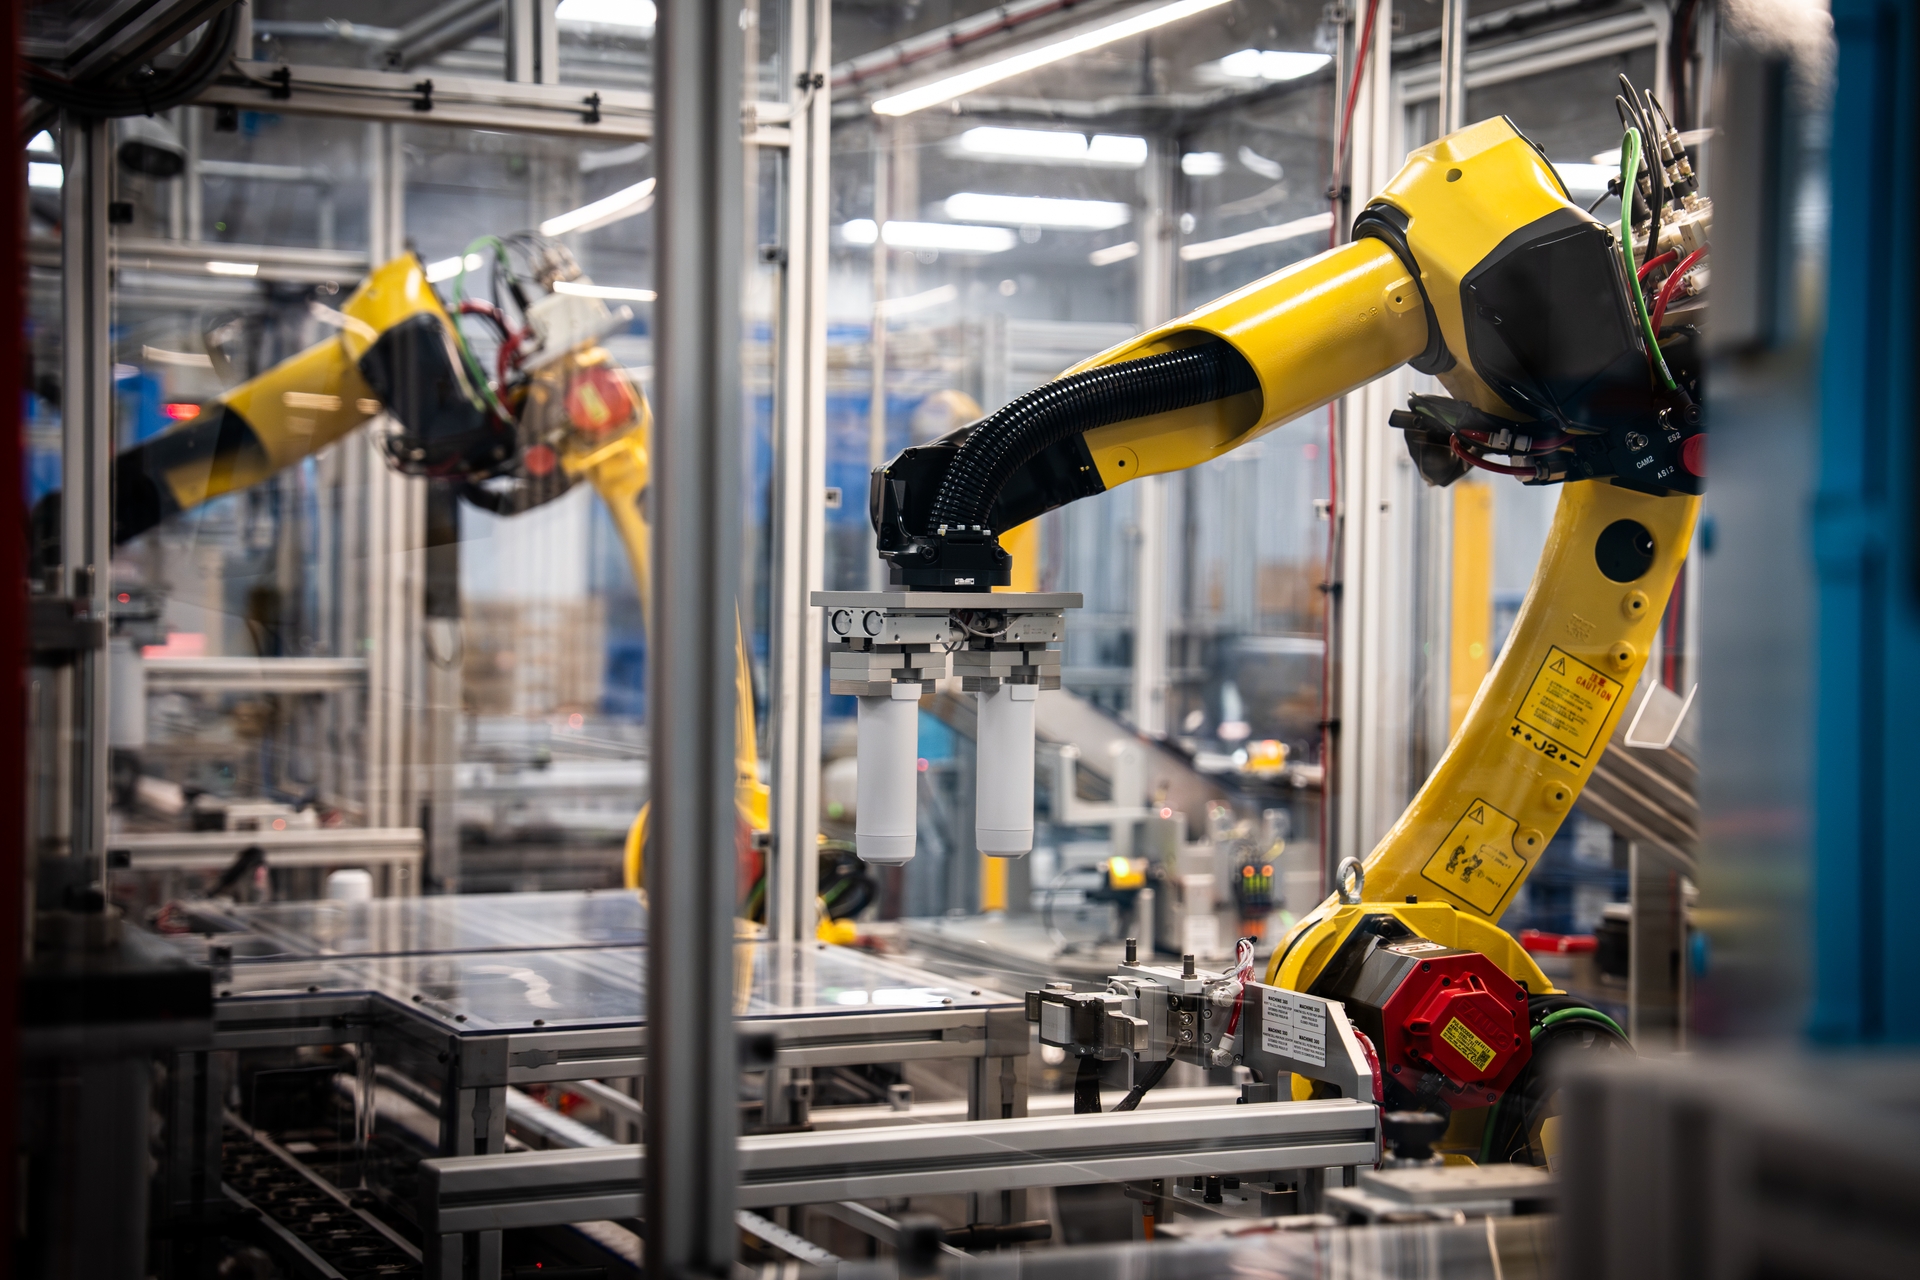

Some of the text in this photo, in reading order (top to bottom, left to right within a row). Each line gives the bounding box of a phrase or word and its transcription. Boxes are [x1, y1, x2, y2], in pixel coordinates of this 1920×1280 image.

[1667, 431, 1682, 444] ES2
[1636, 455, 1655, 469] CAM2
[1576, 675, 1612, 702] CAUTION
[1533, 740, 1559, 759] J2
[1456, 999, 1508, 1047] FANUC
